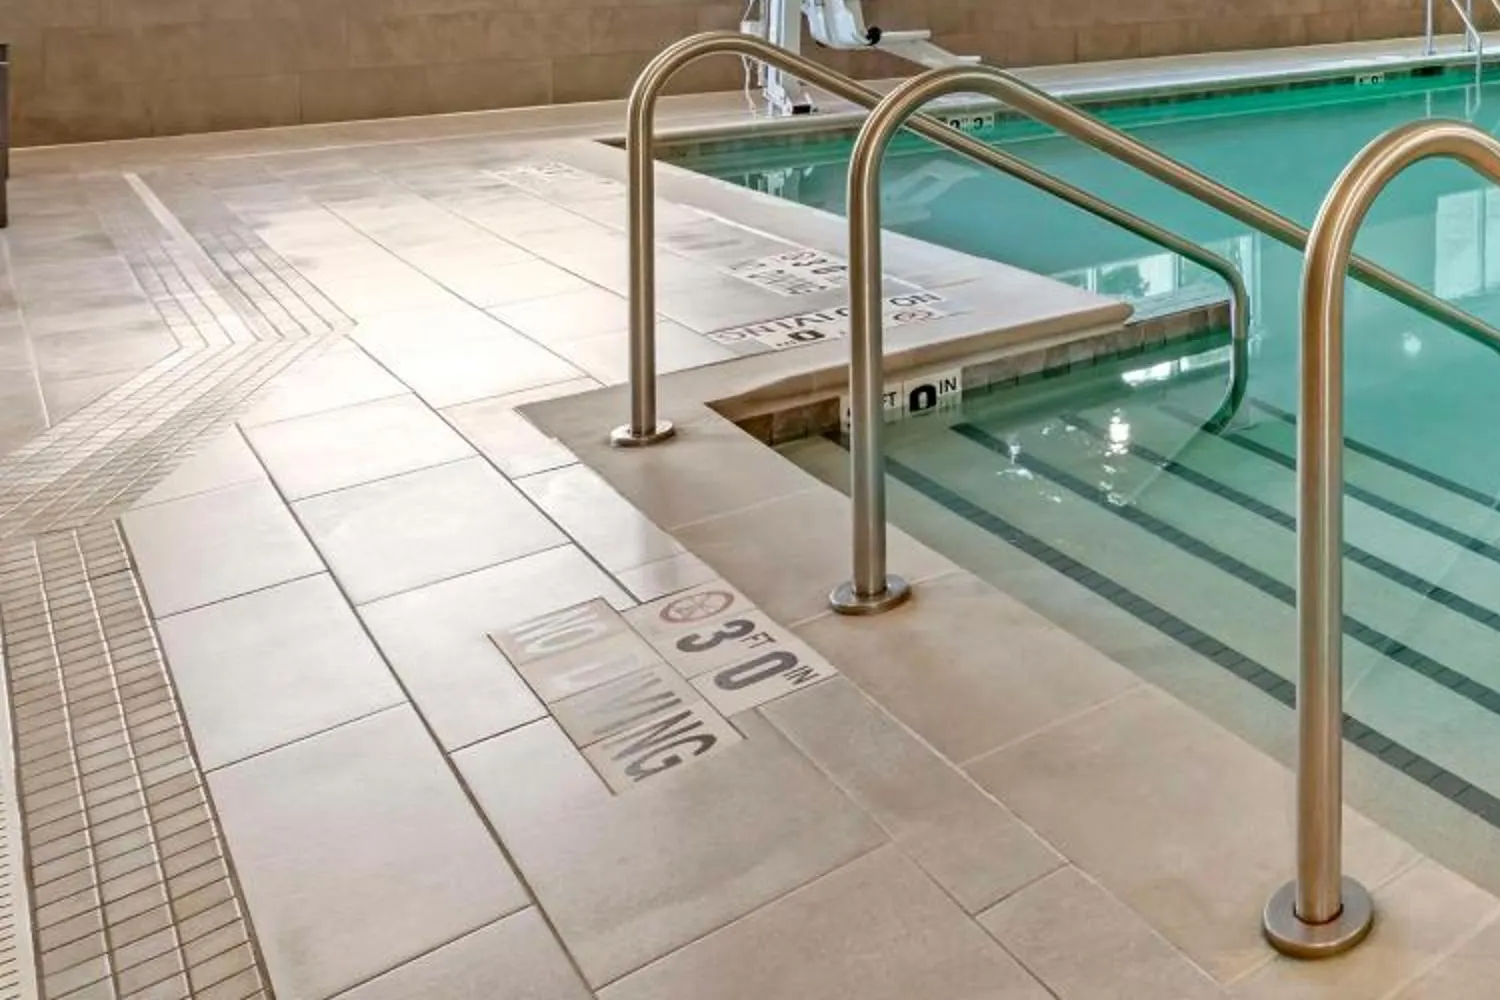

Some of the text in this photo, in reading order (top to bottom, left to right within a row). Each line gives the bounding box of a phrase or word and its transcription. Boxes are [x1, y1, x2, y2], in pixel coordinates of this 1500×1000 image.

[939, 376, 957, 395] IN
[675, 618, 822, 690] 3 FT 0 IN
